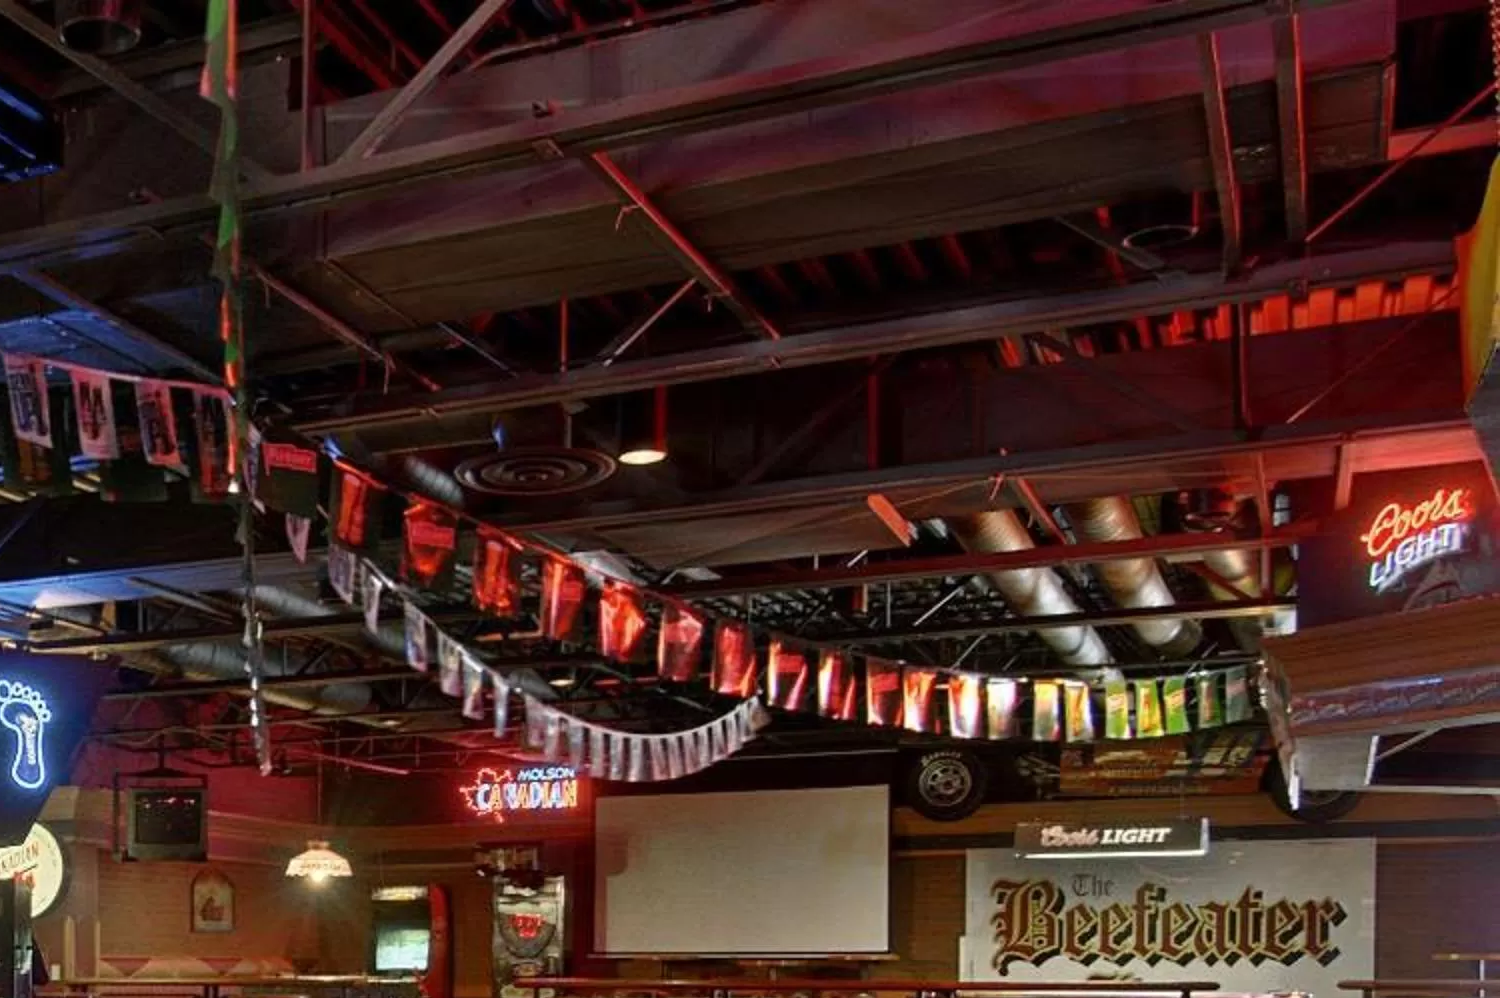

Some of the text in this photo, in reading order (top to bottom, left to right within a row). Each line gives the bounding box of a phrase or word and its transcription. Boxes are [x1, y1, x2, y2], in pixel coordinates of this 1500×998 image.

[1360, 488, 1467, 557] Coors
[1369, 522, 1463, 588] LIGHT
[517, 766, 576, 781] MOLSON
[476, 779, 578, 811] CANADIAN
[1041, 825, 1173, 847] Coors LIGHT
[1070, 872, 1115, 897] The
[990, 879, 1348, 976] Beefeater
